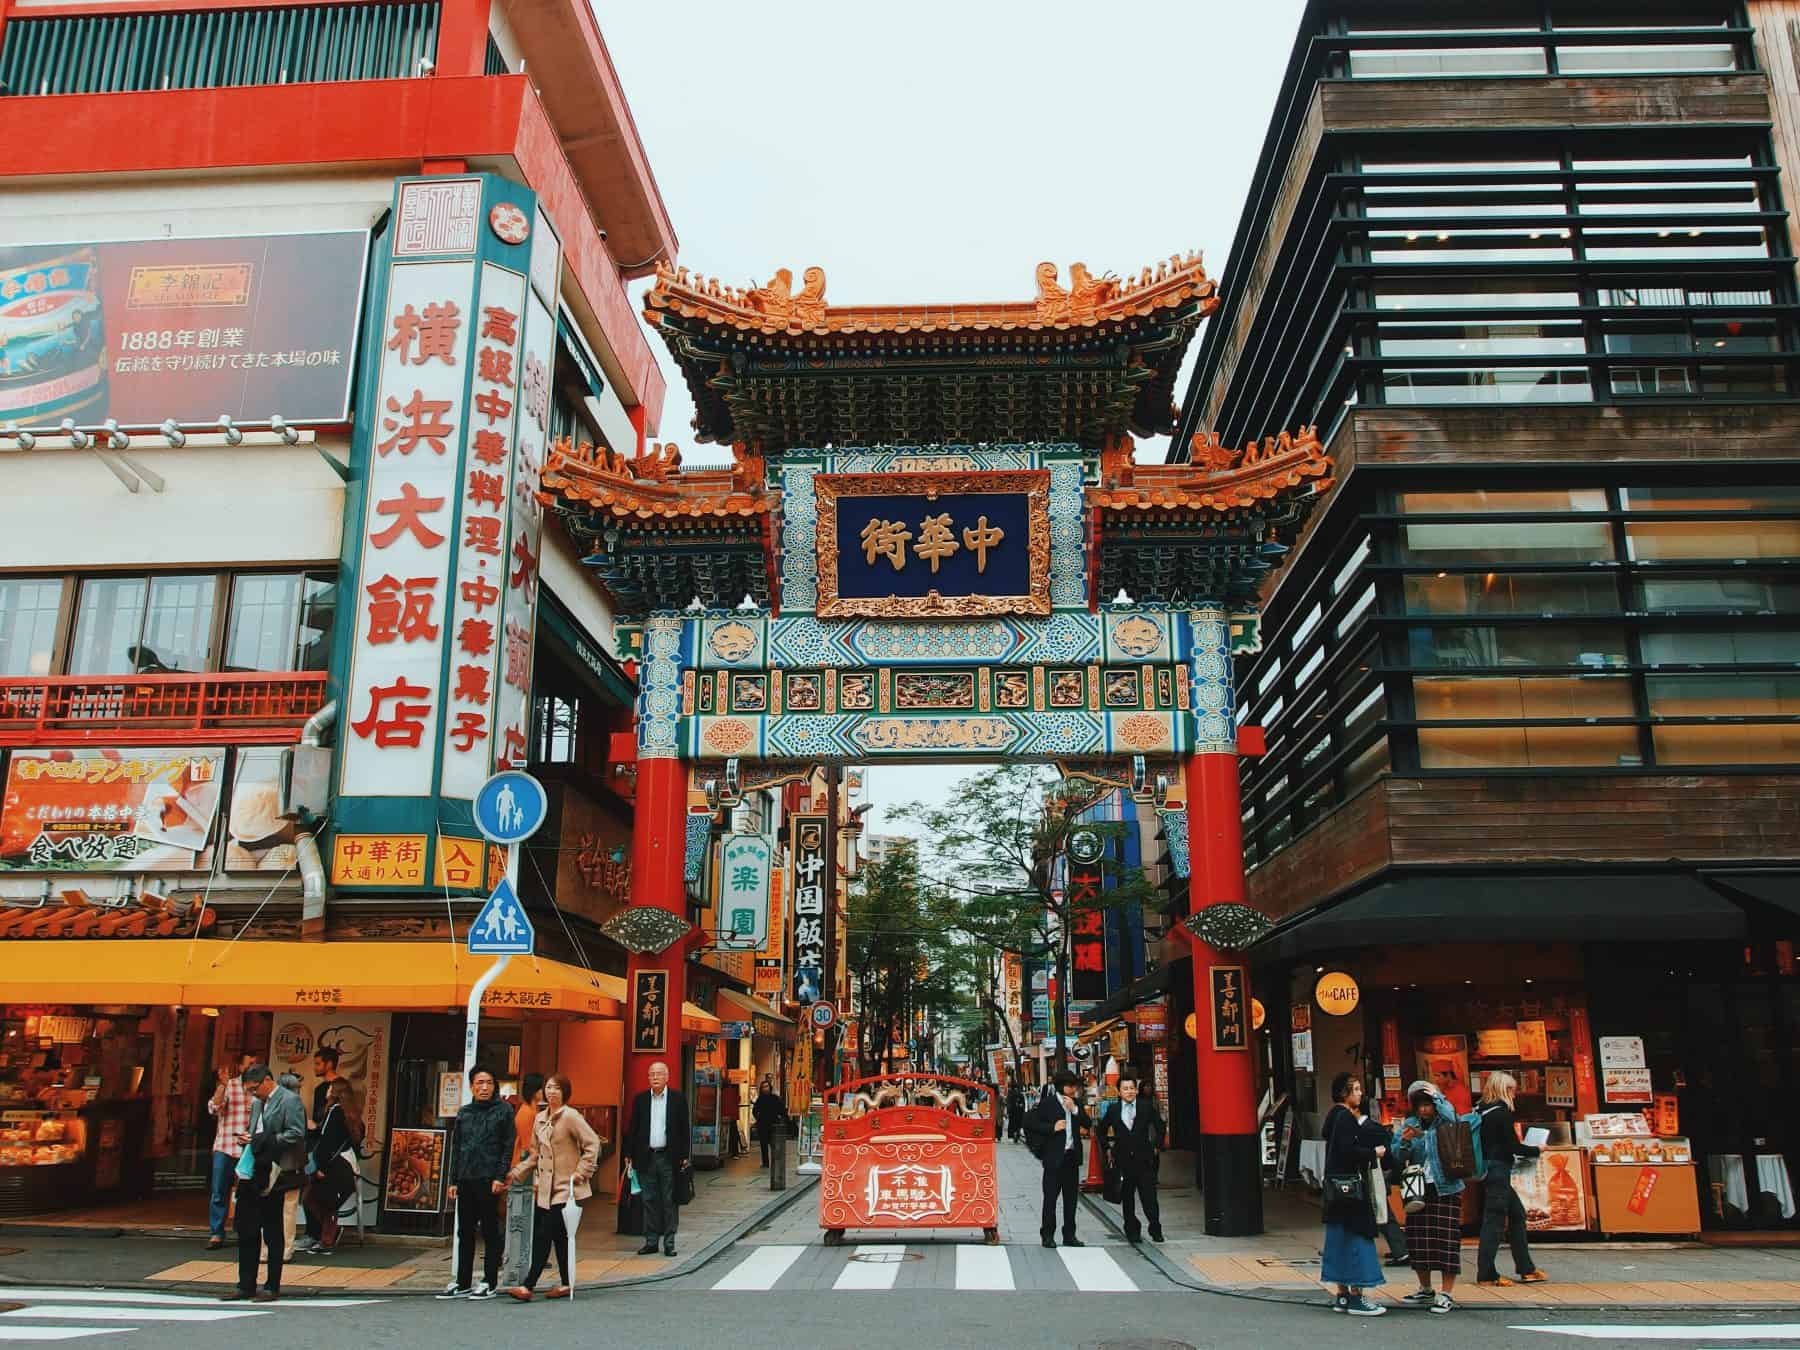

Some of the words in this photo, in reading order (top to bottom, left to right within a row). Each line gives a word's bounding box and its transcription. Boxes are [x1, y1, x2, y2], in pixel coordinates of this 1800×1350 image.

[120, 328, 245, 350] 1888年創業
[115, 350, 342, 373] 伝統を守り続けてきた本場の味
[351, 301, 461, 748] 横浜大飯店
[29, 833, 138, 862] 食べ放題
[343, 840, 422, 864] 中華街
[342, 866, 419, 881] 大通り入口
[446, 844, 475, 883] 入口
[731, 866, 760, 935] 楽園
[815, 1008, 831, 1022] 30
